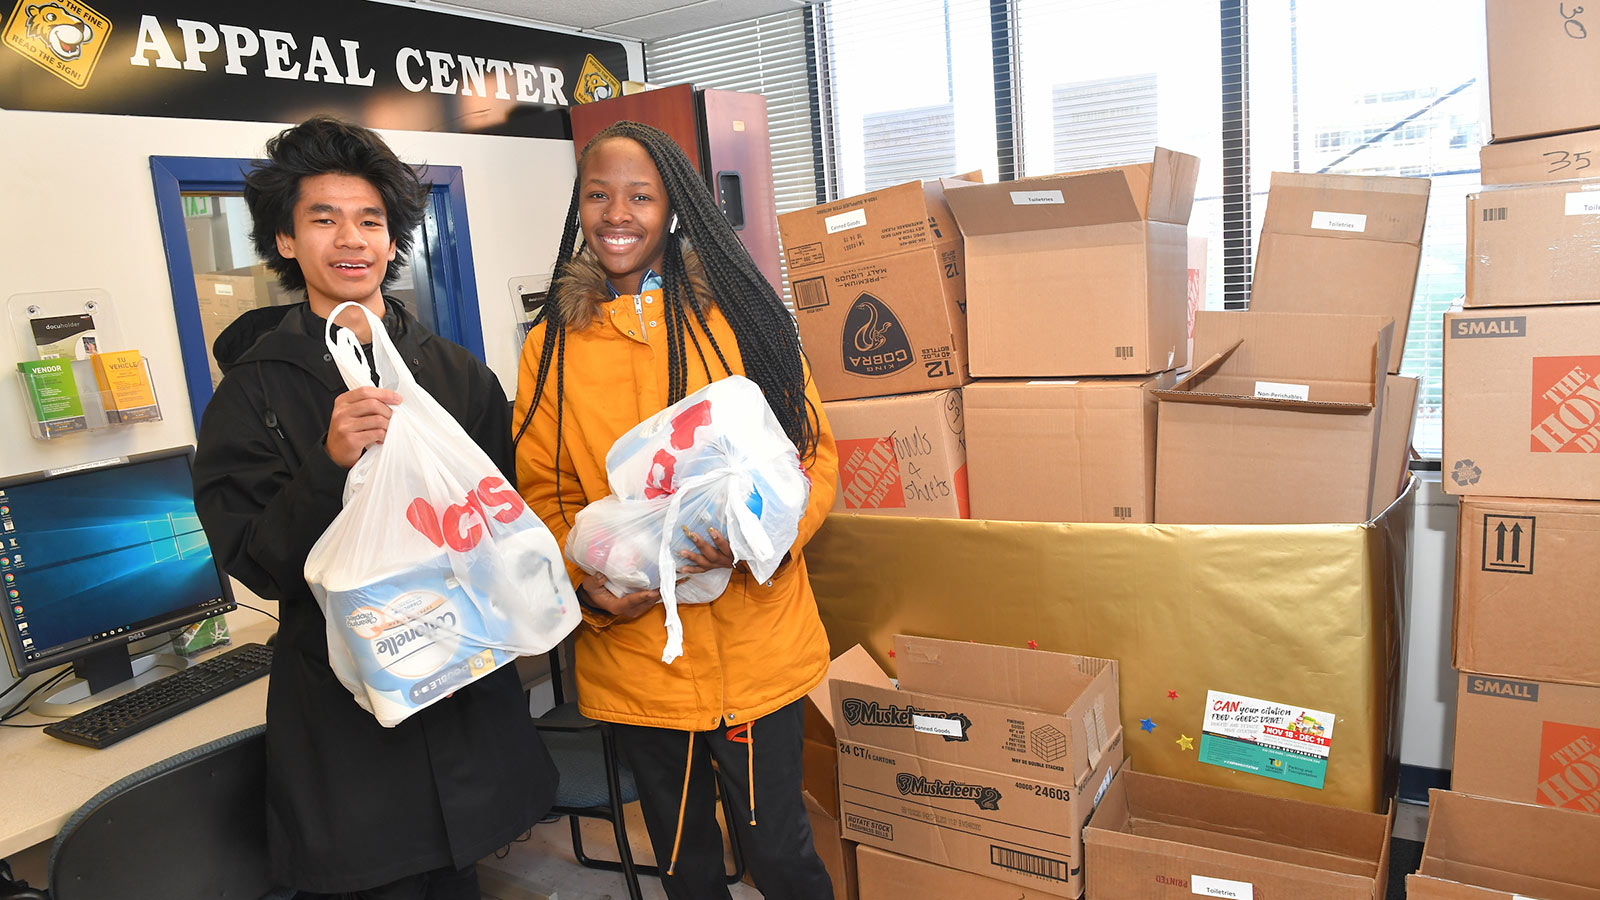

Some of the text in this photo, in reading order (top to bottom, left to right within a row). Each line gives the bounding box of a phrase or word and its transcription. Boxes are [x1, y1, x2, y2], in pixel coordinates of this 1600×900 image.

[66, 1, 103, 30] THE FINE.
[12, 34, 81, 81] READ THE SIGN!
[129, 14, 376, 87] APPEAL
[395, 47, 568, 106] CENTER
[1543, 150, 1592, 174] 35
[831, 223, 847, 231] Canned
[835, 268, 887, 283] MALT LIQUOR
[944, 263, 959, 279] 12
[844, 277, 880, 288] PREMIUM
[1457, 320, 1519, 336] SMALL
[849, 349, 908, 367] COBRA
[921, 346, 950, 354] BOTTLES
[31, 365, 62, 374] VENDOR
[109, 361, 138, 370] VEHICLE
[866, 364, 895, 372] KING
[925, 360, 955, 378] 12
[1542, 366, 1591, 405] THE
[844, 446, 866, 475] THE
[844, 438, 894, 509] HOME
[868, 462, 900, 509] DEPOT
[128, 632, 146, 642] DELL
[1474, 679, 1532, 698] SMALL
[1211, 713, 1230, 721] FOOD
[1234, 714, 1259, 723] GOODS
[1260, 716, 1284, 725] DRIVE!
[1240, 706, 1259, 715] your
[1261, 706, 1291, 716] citation
[914, 724, 933, 732] Canned
[1266, 727, 1284, 736] NOV
[1299, 733, 1315, 742] DEC
[1316, 737, 1325, 745] 11
[840, 743, 851, 755] 24
[872, 754, 897, 766] CARTONS
[1550, 735, 1597, 767] THE
[1045, 763, 1065, 772] STACKED
[1268, 757, 1282, 767] TU
[1288, 769, 1318, 778] Transportation
[911, 777, 982, 799] Musketeers
[848, 816, 890, 833] ROTATE STOCK
[1155, 875, 1188, 888] PRINTED
[1206, 887, 1236, 897] Toiletries
